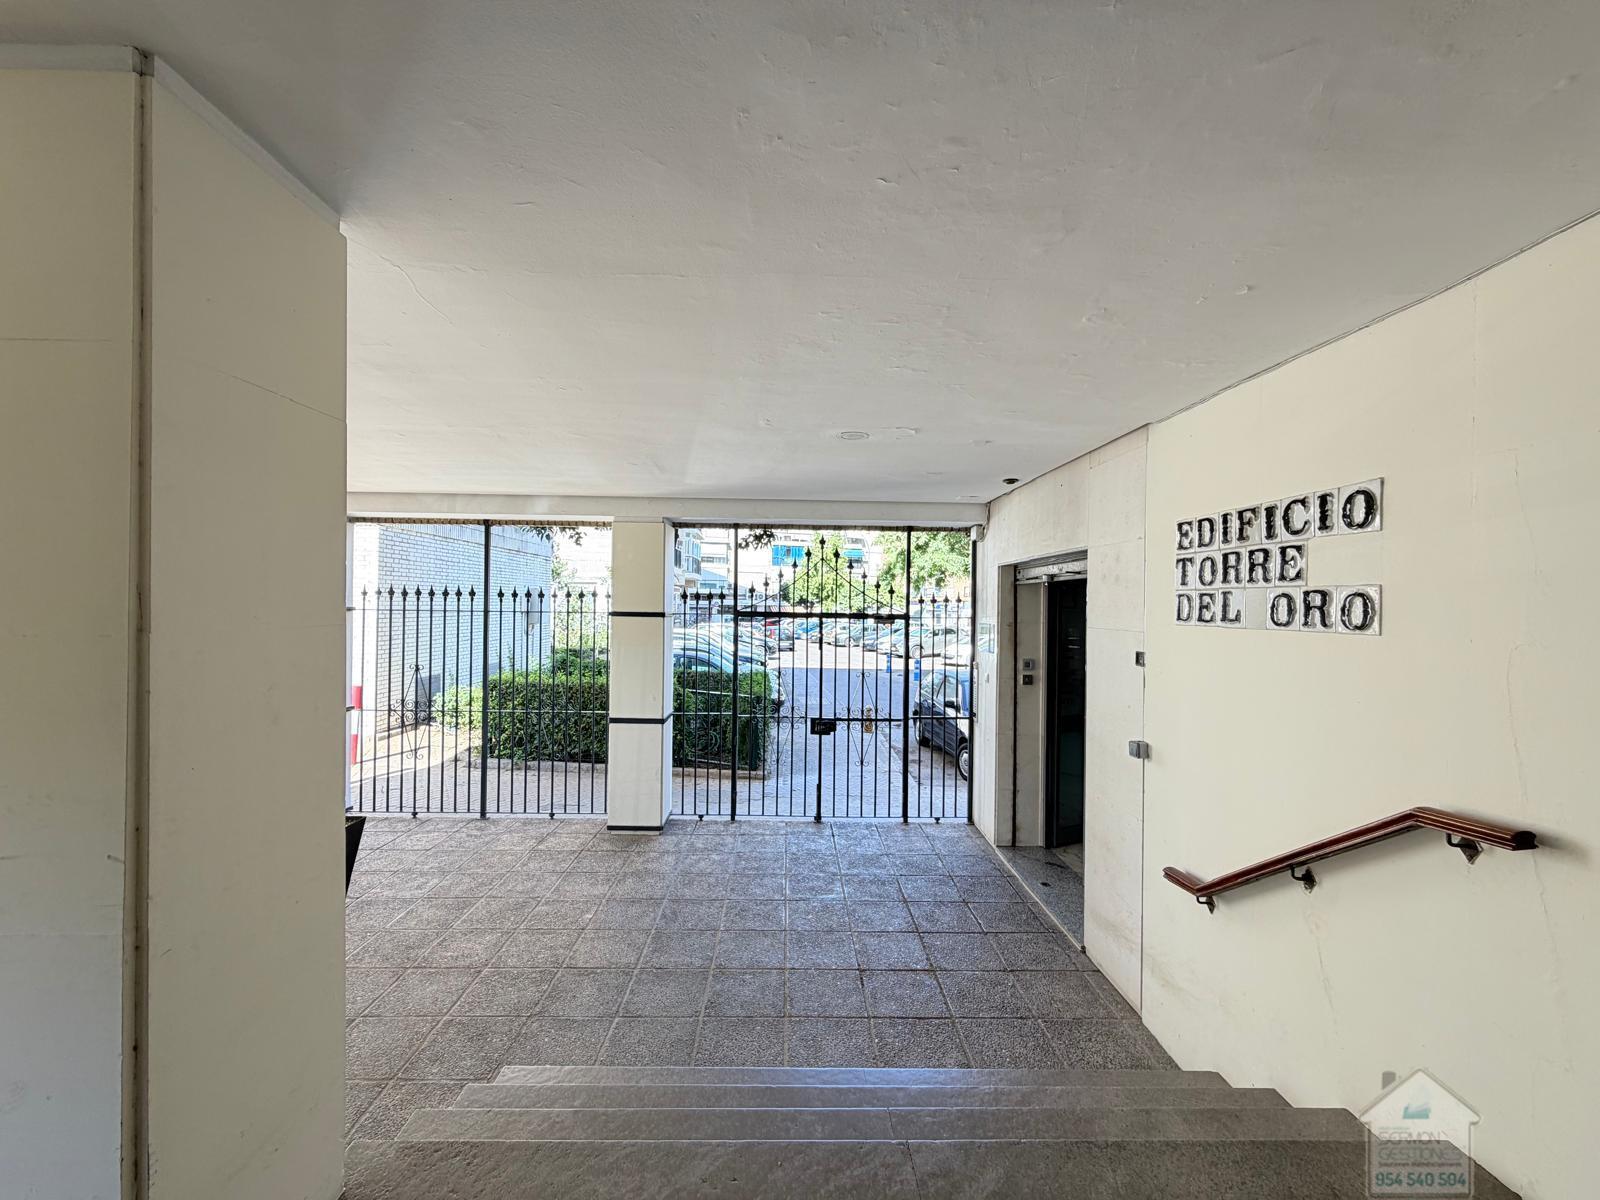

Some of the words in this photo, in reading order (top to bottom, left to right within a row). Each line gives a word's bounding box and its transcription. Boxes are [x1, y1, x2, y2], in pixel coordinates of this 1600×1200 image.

[1176, 489, 1378, 551] EDIFICIO
[1176, 544, 1305, 587] TORRE
[1176, 591, 1241, 622] DEL
[1270, 589, 1377, 631] ORO
